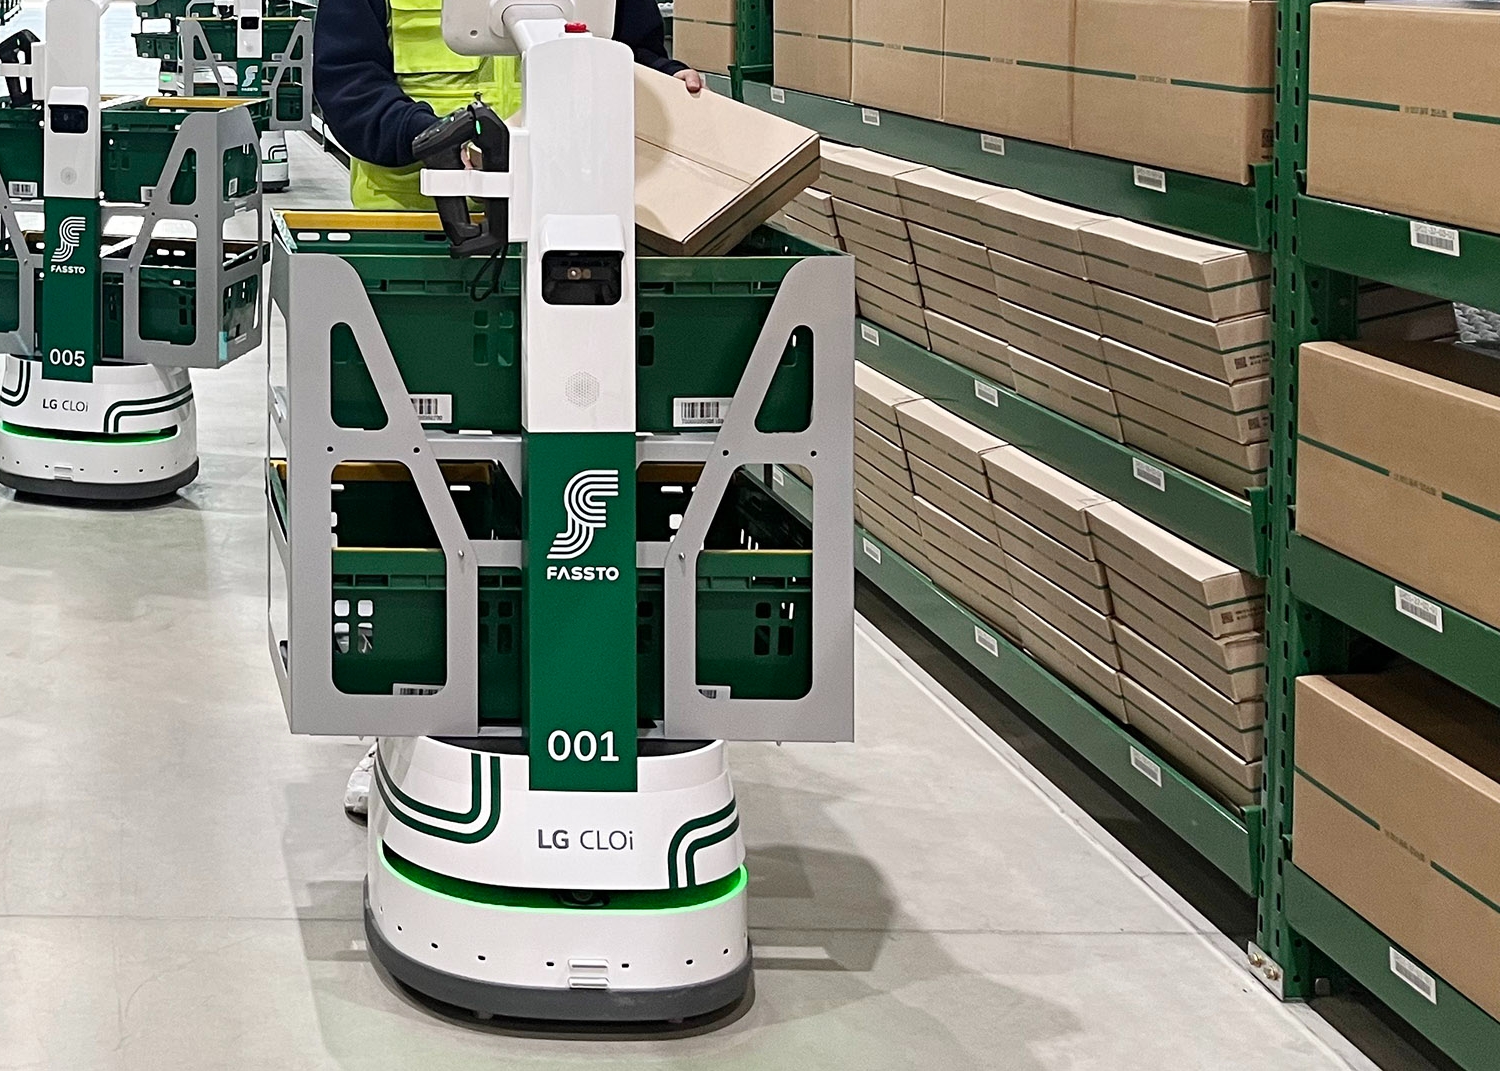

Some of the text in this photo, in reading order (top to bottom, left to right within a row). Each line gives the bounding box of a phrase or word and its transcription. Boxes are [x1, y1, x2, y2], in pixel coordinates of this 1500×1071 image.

[50, 265, 86, 275] FASSTO
[49, 349, 86, 367] 005
[42, 398, 89, 413] LG CLOi
[546, 566, 620, 581] FASSTO
[547, 730, 620, 762] 001
[538, 829, 634, 851] LG CLOi
